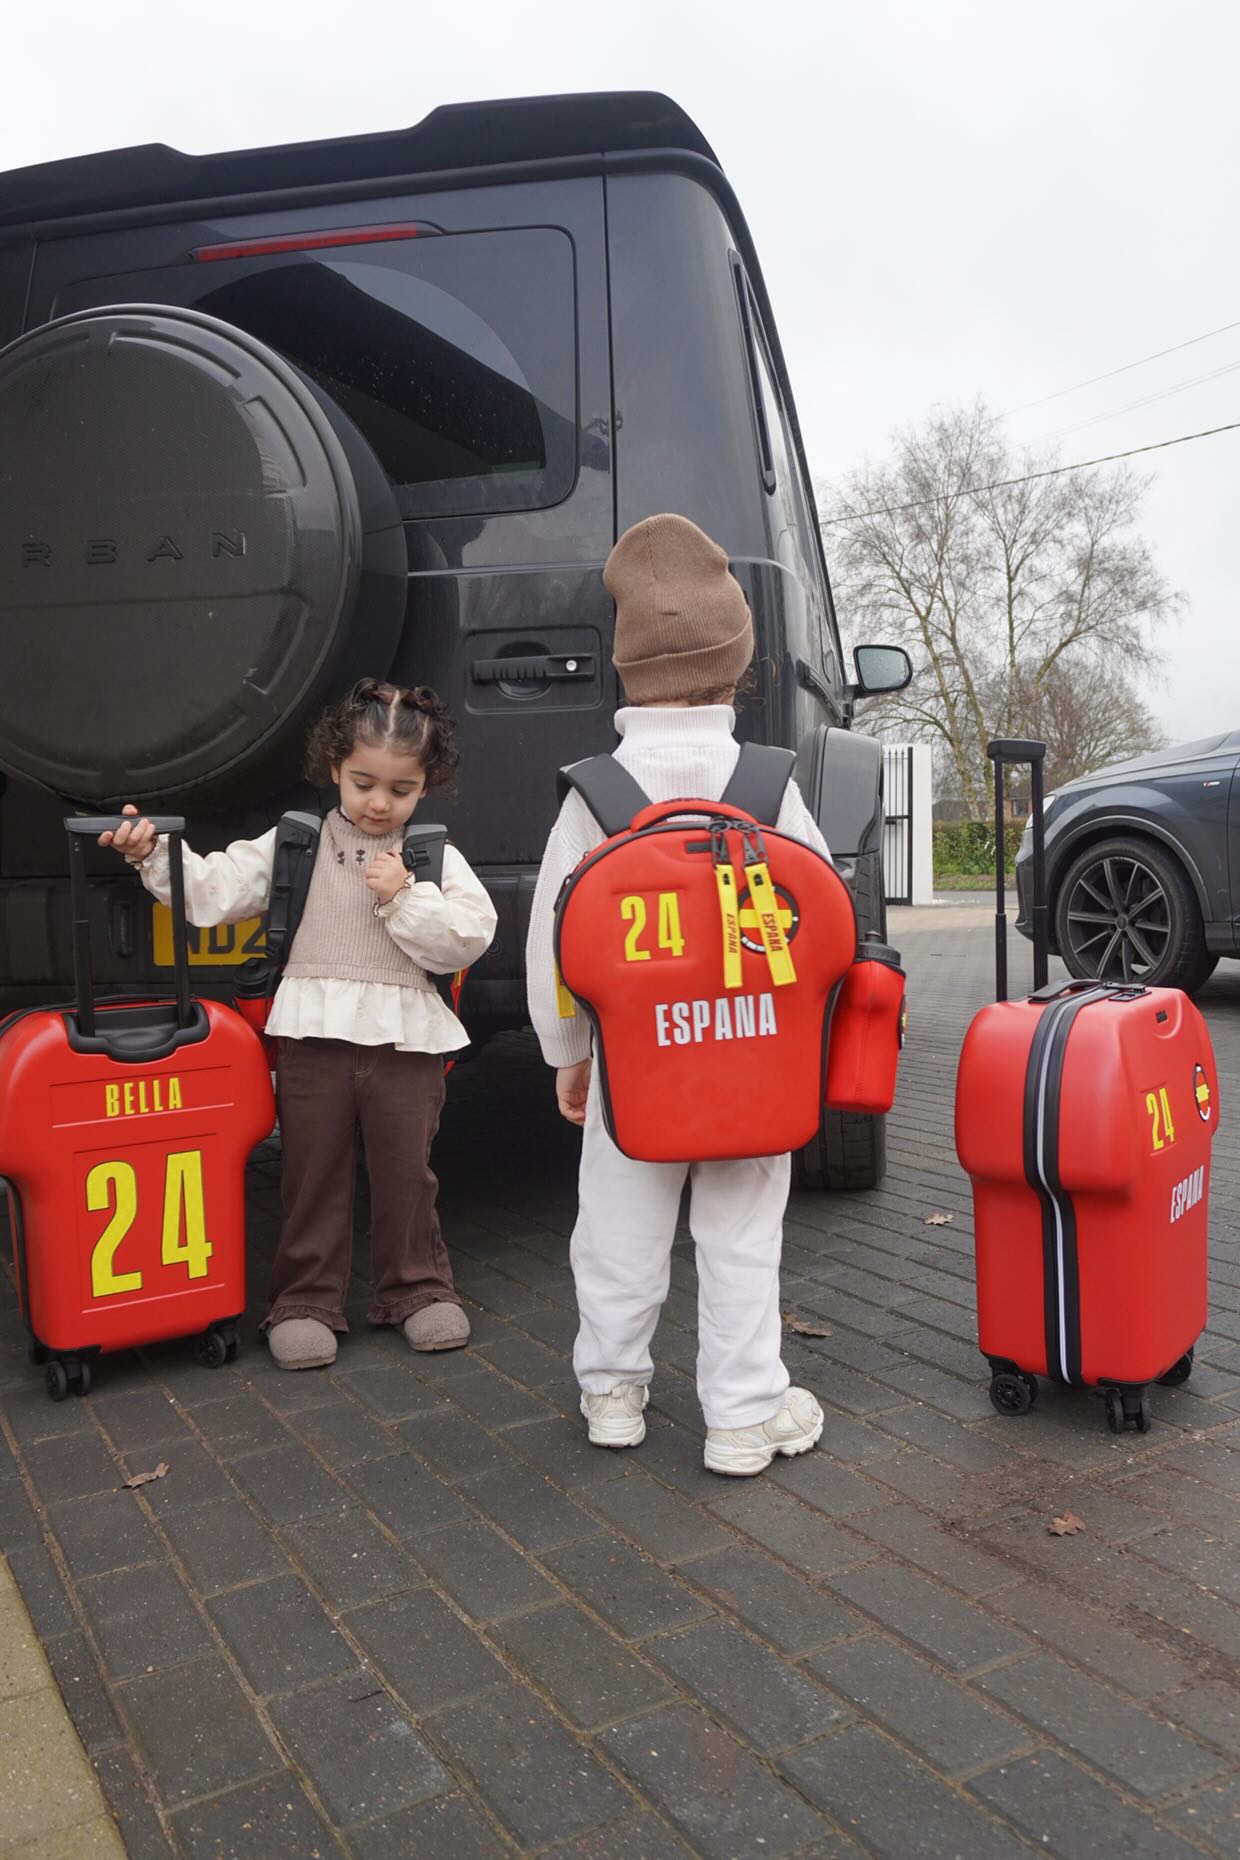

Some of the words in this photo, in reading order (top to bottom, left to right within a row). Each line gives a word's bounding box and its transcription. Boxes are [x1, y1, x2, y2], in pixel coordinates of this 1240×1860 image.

[620, 892, 685, 961] 24
[761, 912, 783, 952] ESPANA
[655, 993, 777, 1046] ESPANA
[105, 1077, 183, 1118] BELLA
[1146, 1087, 1175, 1151] 24
[86, 1149, 213, 1298] 24
